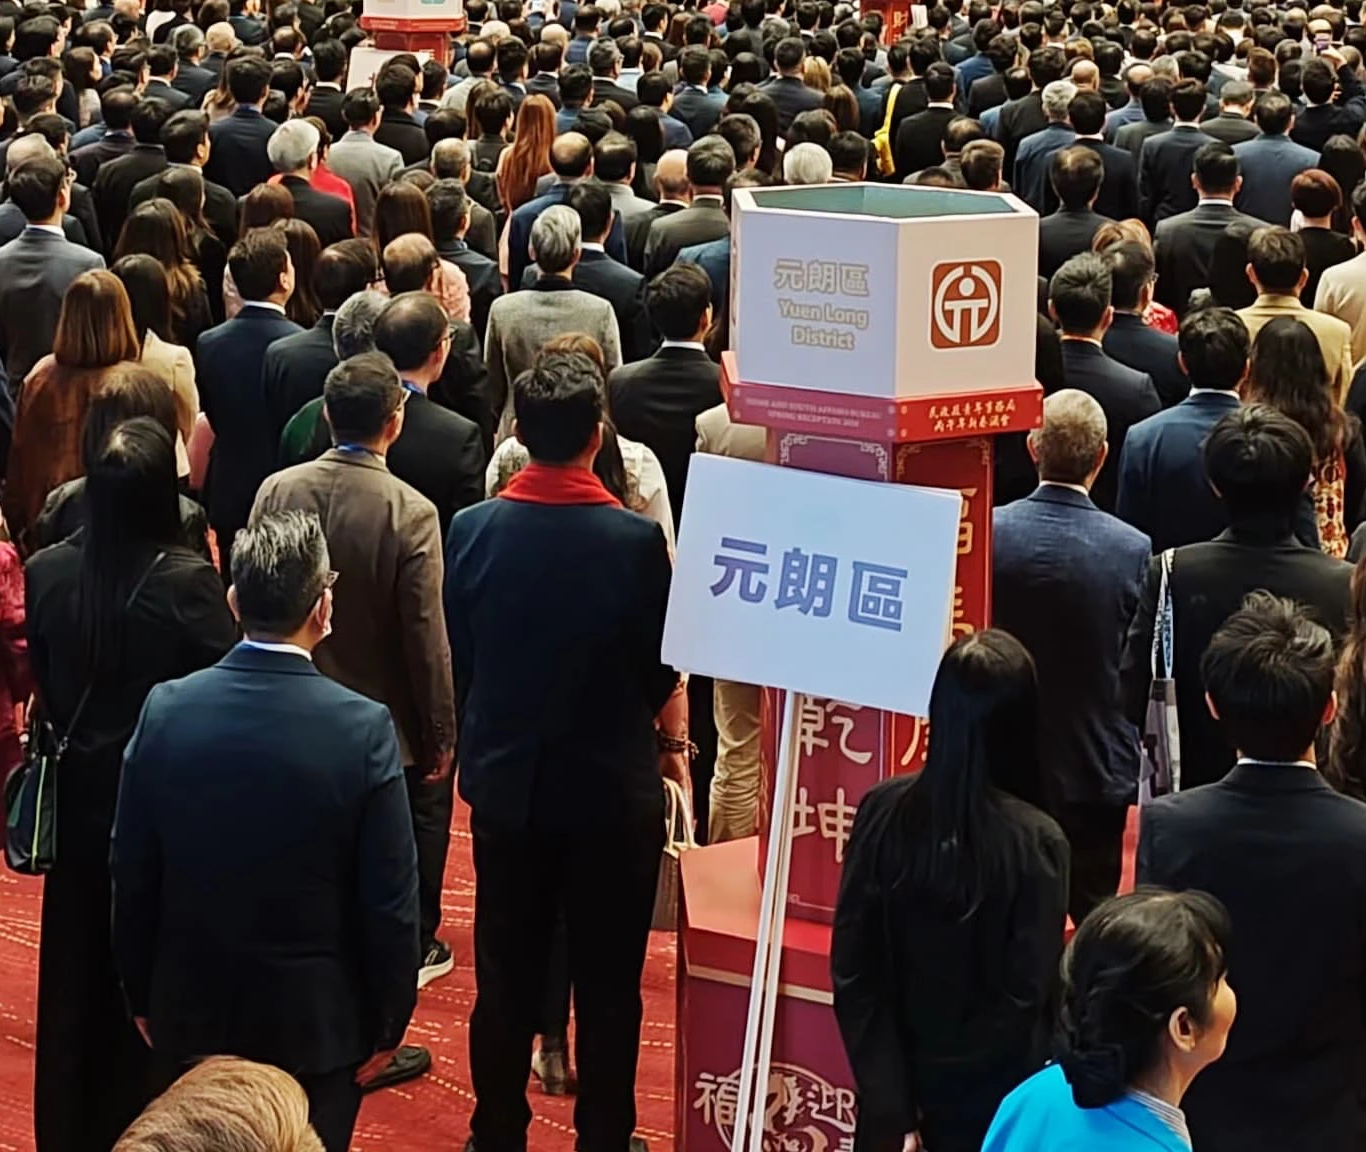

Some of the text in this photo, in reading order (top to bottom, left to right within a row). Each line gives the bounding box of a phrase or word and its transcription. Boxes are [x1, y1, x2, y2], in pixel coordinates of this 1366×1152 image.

[774, 259, 869, 296] 元朗區
[778, 298, 869, 329] Yuen Long
[791, 325, 855, 350] District
[709, 537, 907, 632] 元朗區
